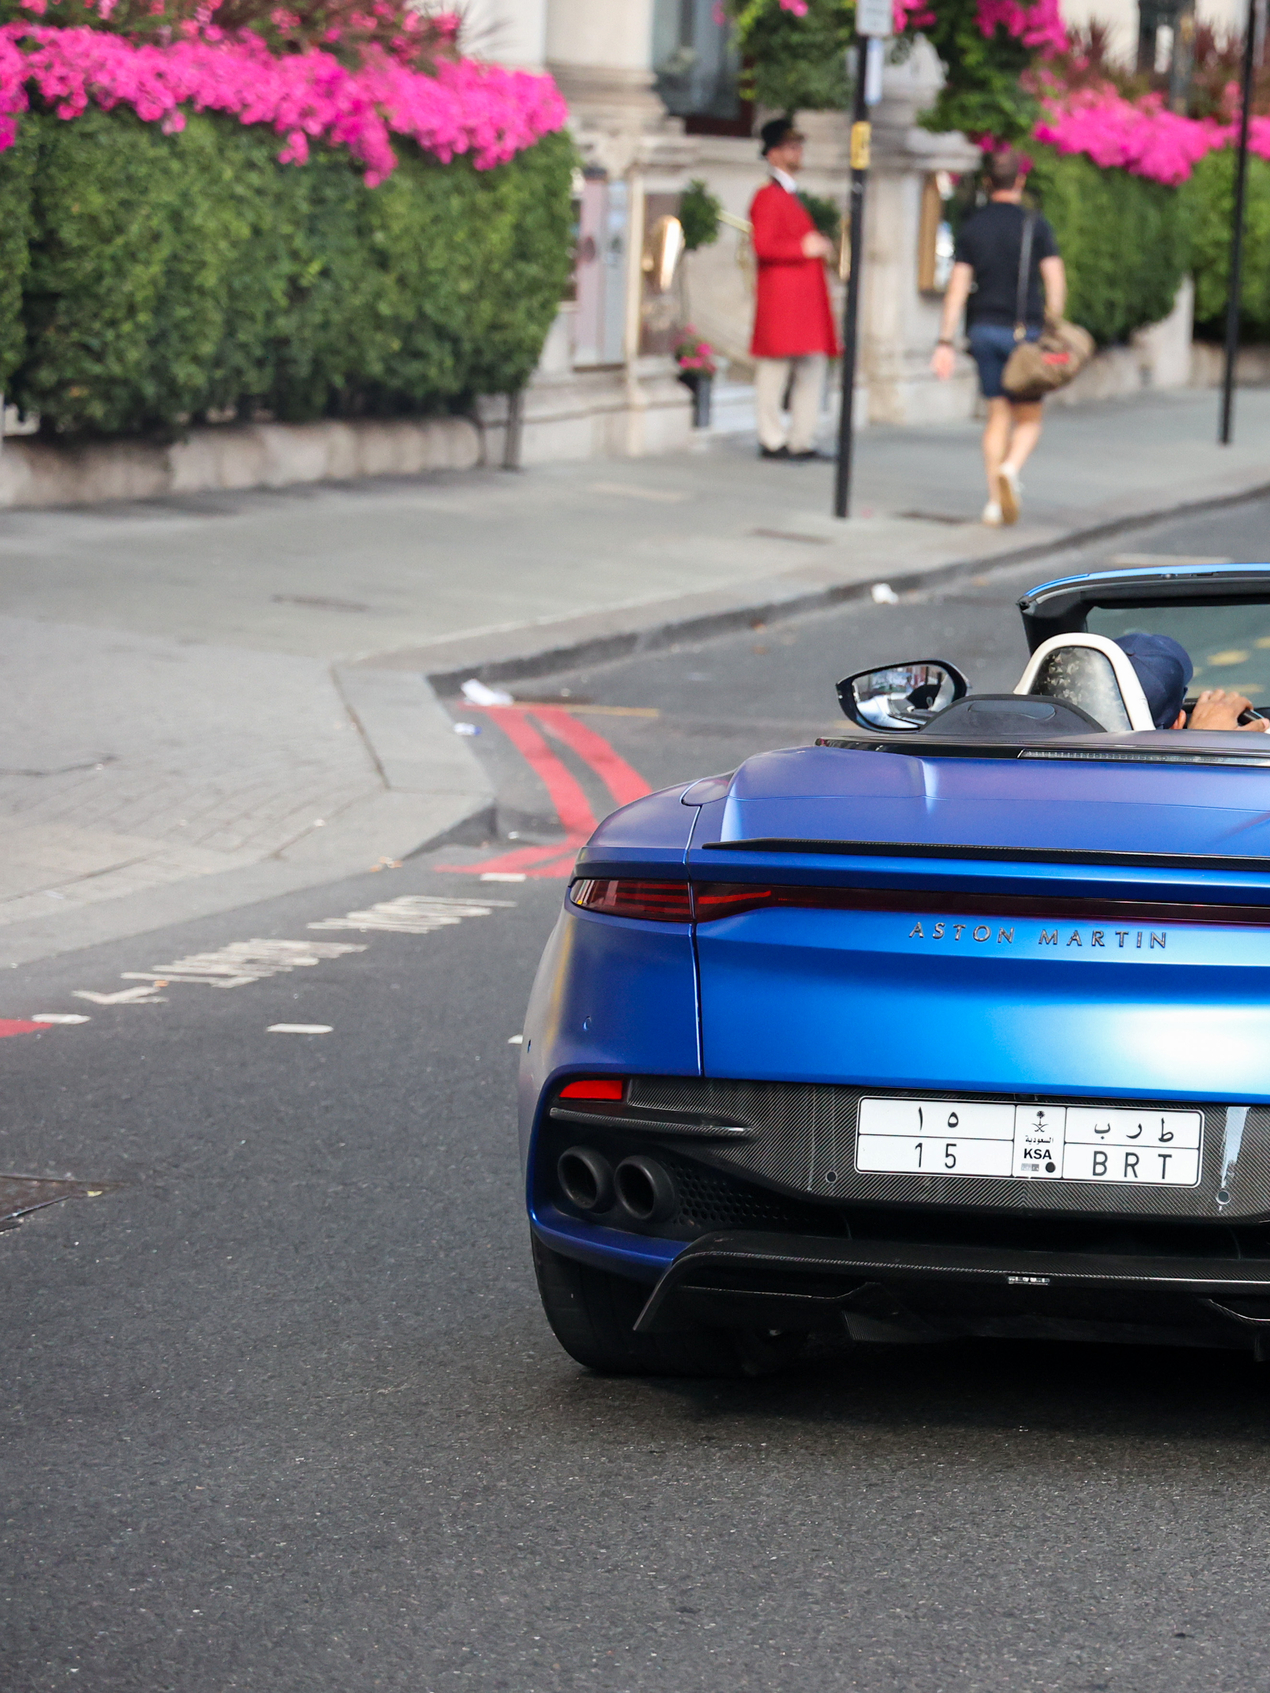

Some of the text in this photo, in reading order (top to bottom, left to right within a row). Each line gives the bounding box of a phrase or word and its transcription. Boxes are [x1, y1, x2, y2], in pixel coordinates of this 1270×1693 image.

[909, 921, 1167, 949] ASTON MARTIN
[1024, 1148, 1052, 1160] KSA
